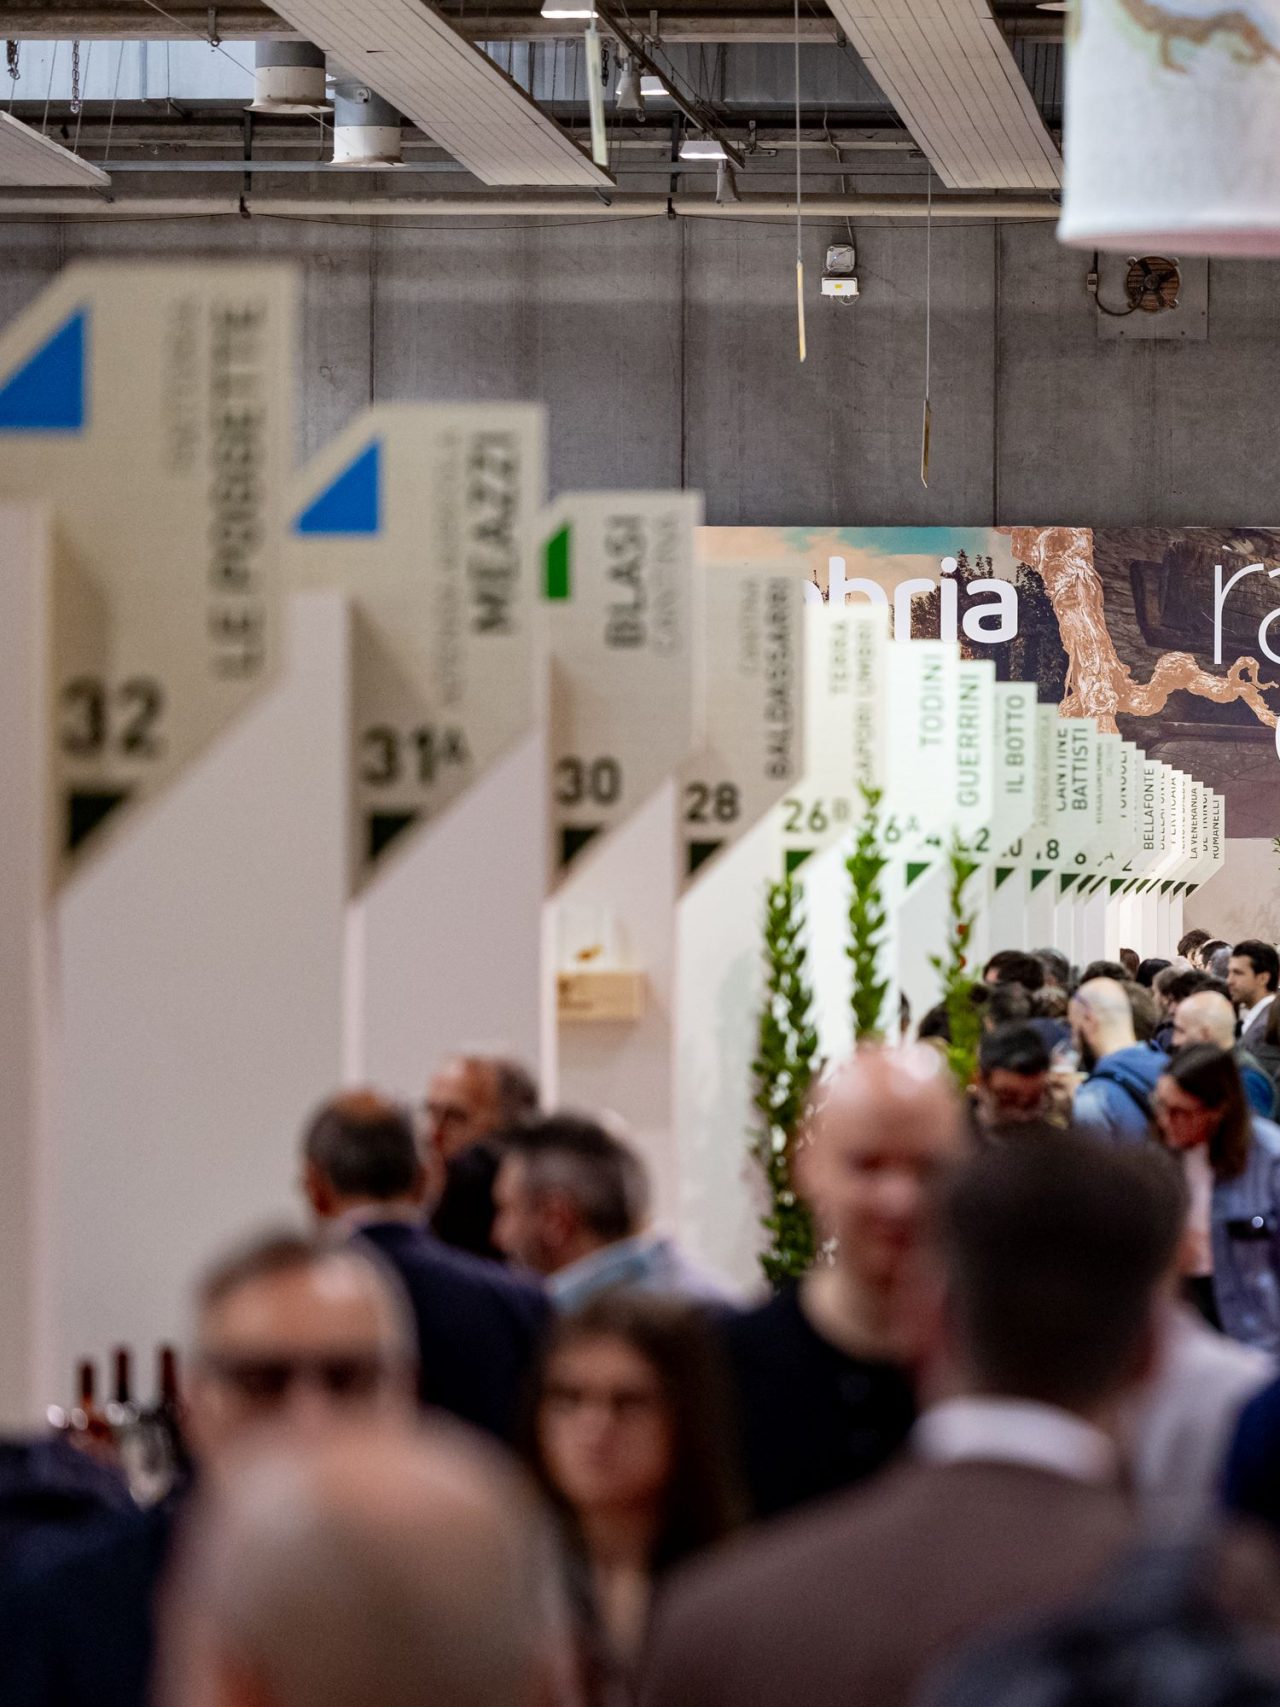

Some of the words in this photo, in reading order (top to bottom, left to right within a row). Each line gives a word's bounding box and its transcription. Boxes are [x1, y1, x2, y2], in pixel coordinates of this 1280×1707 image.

[803, 556, 1019, 644] bria
[62, 676, 165, 758] 32
[919, 653, 943, 749] TODINI
[956, 673, 980, 807] GUERRINI
[1006, 694, 1025, 767] BOTTO
[557, 755, 622, 806] 30
[685, 782, 740, 824] 28
[1006, 774, 1025, 794] IL
[1071, 727, 1088, 811] BATTISTI
[1143, 767, 1155, 850] BELLAFONTE
